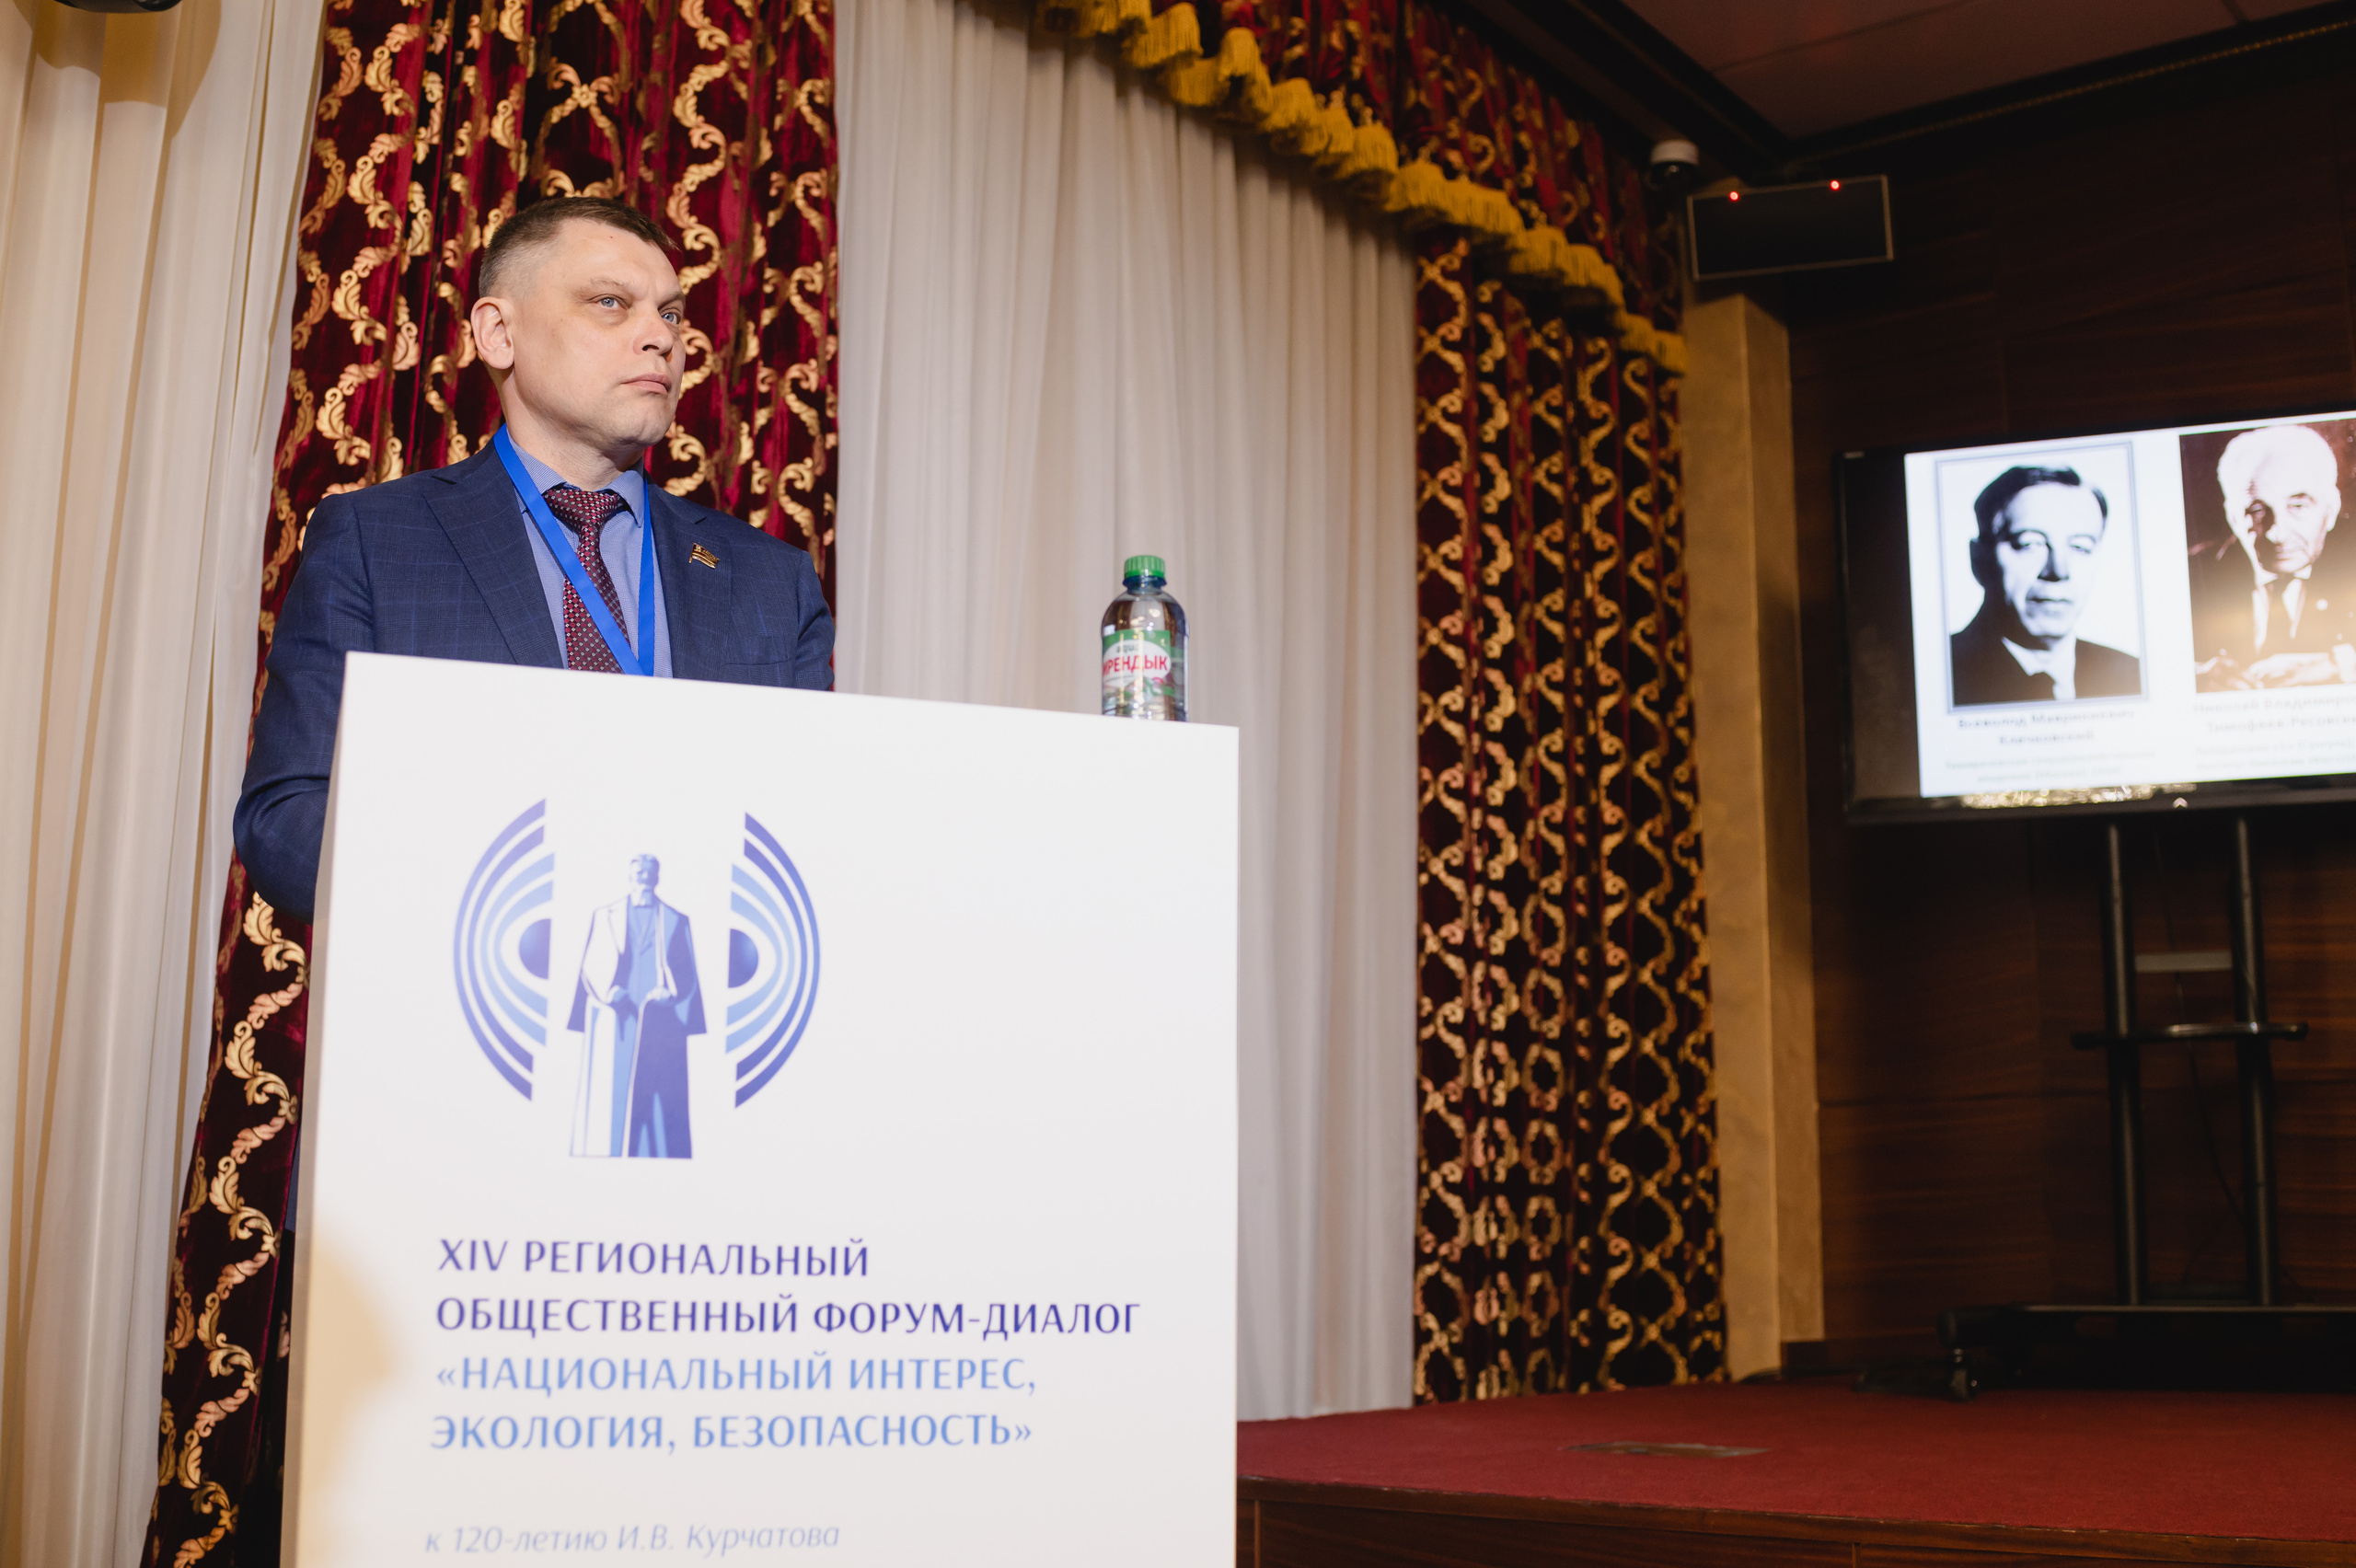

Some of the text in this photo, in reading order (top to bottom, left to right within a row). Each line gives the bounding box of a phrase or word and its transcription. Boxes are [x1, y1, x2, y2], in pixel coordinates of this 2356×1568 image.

[437, 1238, 869, 1277] XIV РЕГИОНАЛЬНЫЙ
[435, 1293, 1141, 1341] ОБЩЕСТВЕННЫЙ ФОРУМ-ДИАЛОГ
[436, 1351, 1036, 1397] «НАЦИОНАЛЬНЫЙ ИНТЕРЕС,
[430, 1413, 1033, 1454] ЭКОЛОГИЯ, БЕЗОПАСНОСТЬ»
[425, 1523, 841, 1557] к 120-летию И.В. Курчатова
